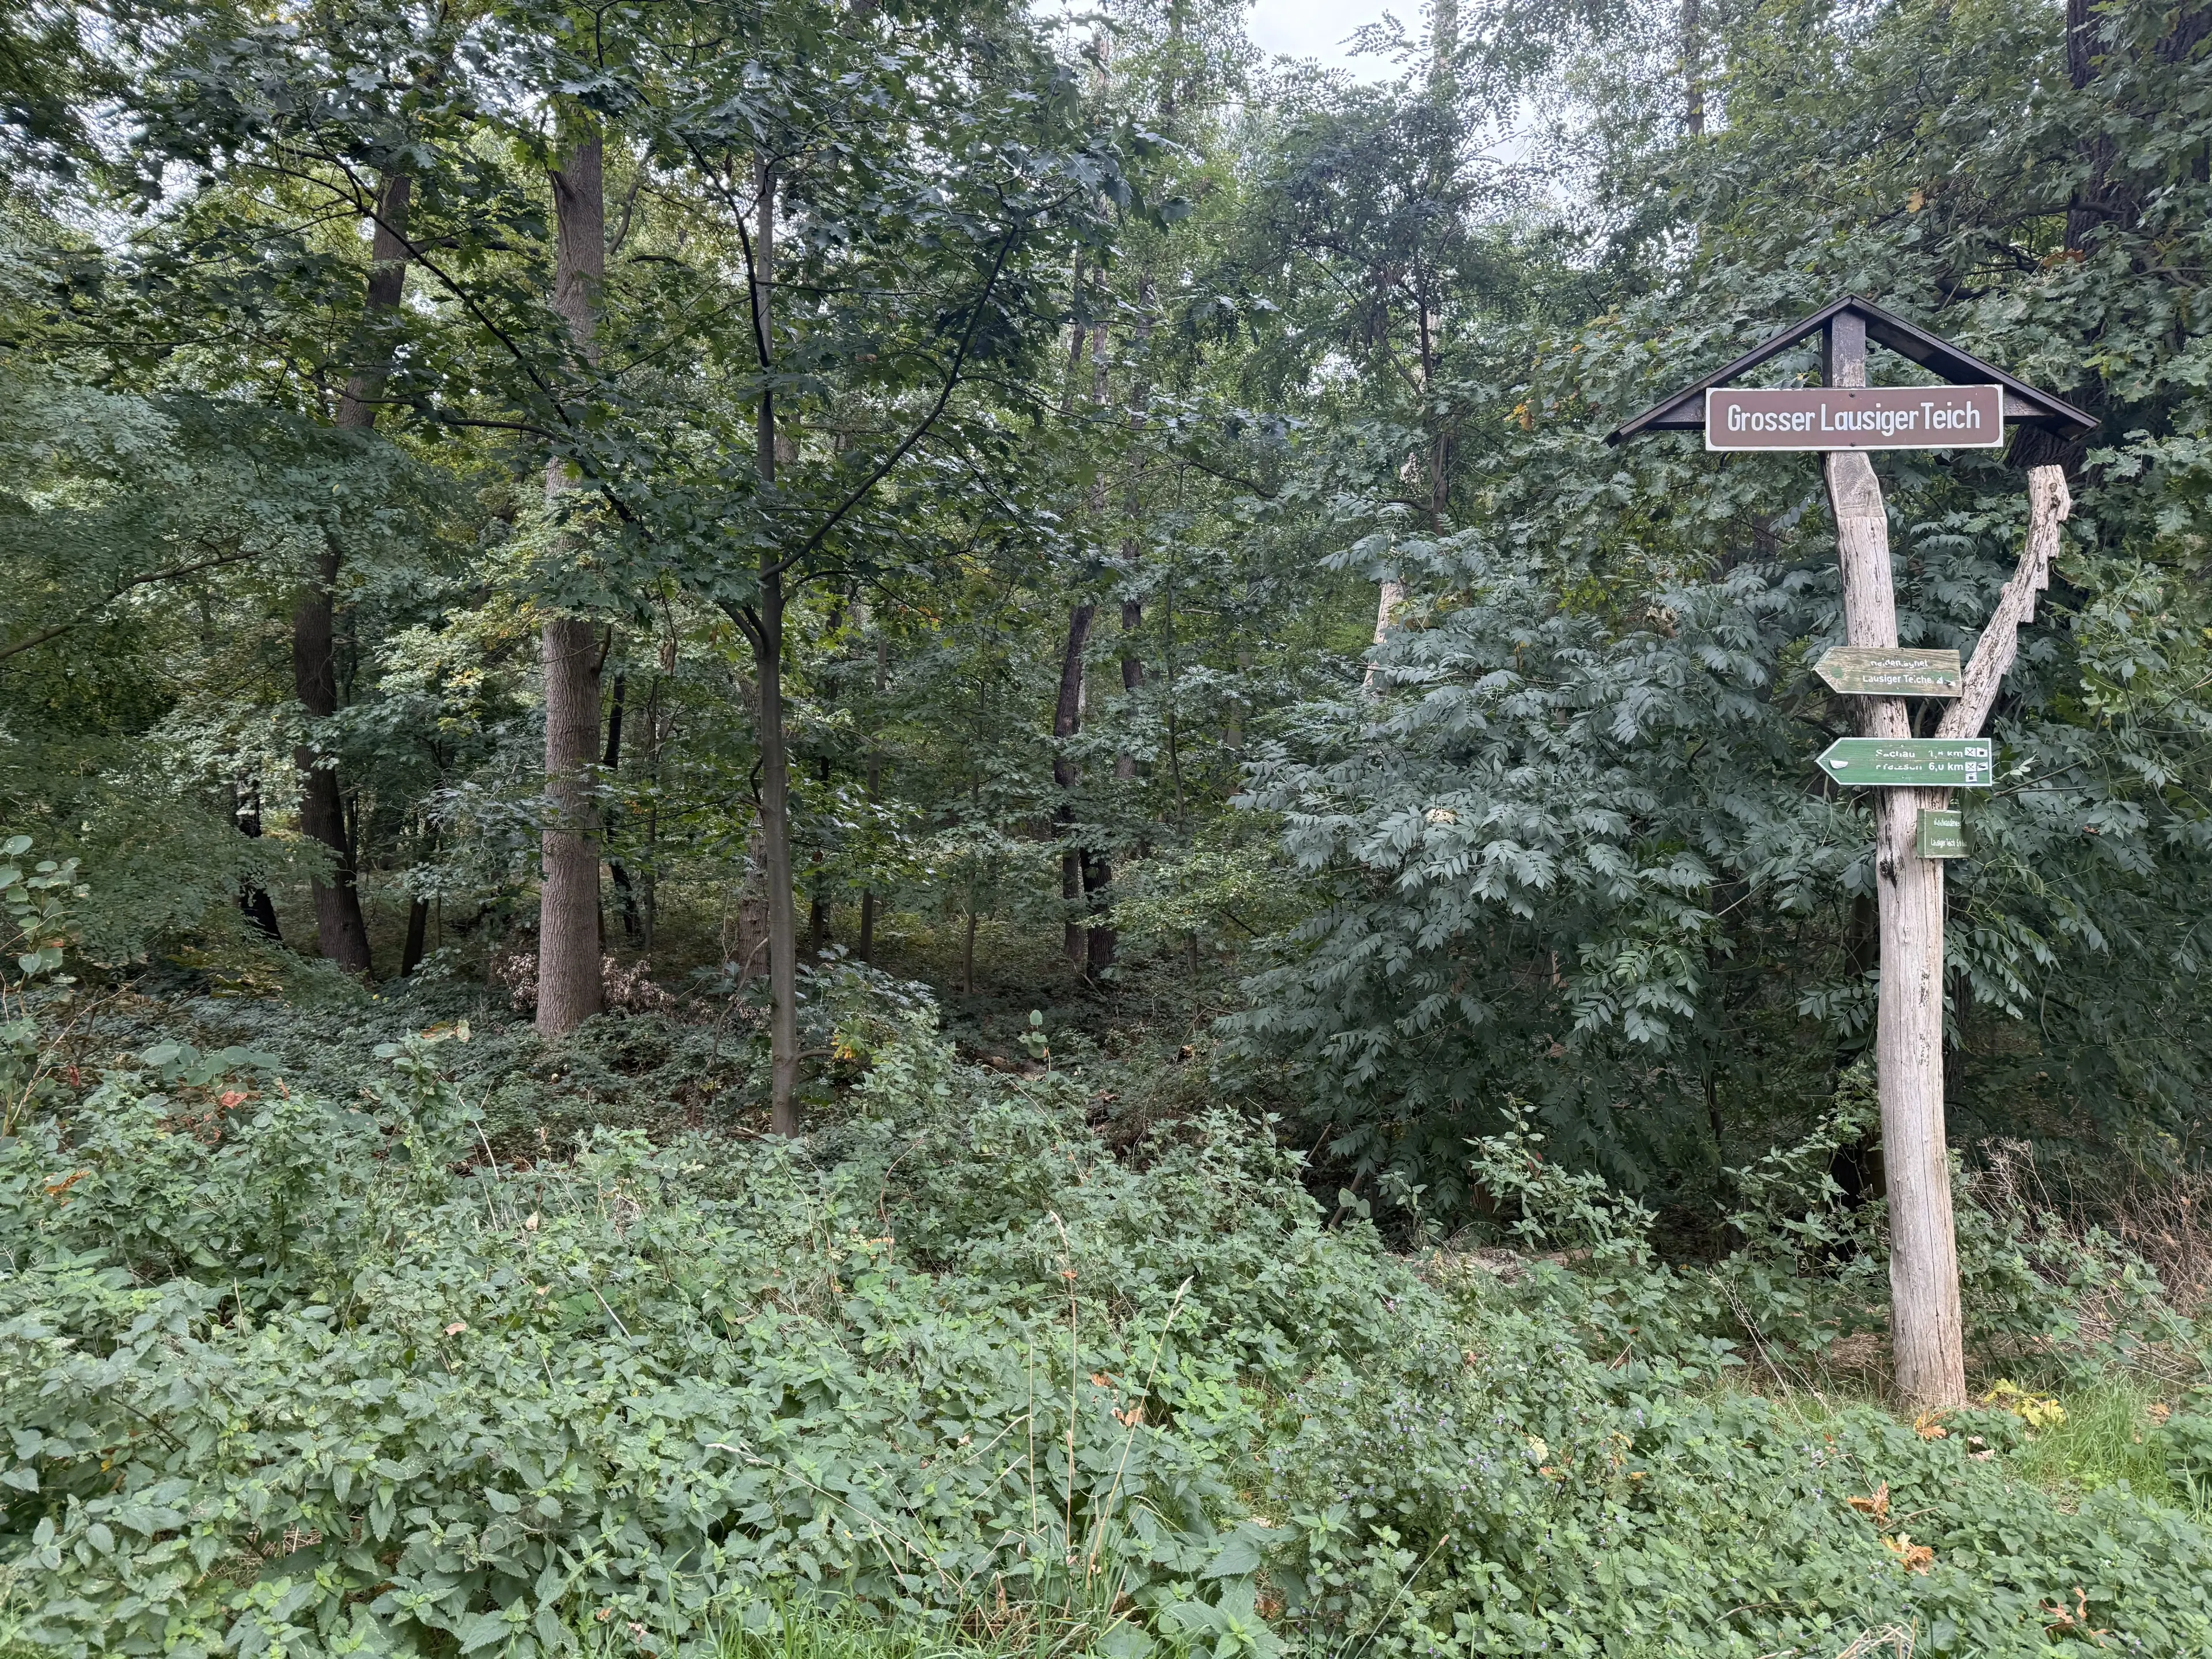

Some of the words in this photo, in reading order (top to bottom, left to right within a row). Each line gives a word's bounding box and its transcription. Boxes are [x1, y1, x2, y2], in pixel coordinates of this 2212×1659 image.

[1728, 404, 1815, 431] Grosser
[1821, 403, 1919, 437] Lausiger
[1921, 401, 1980, 430] Teich
[1862, 674, 1901, 684] Lausiger
[1903, 674, 1932, 684] Teiche
[1929, 762, 1944, 772] 6,0
[1948, 762, 1964, 771] km
